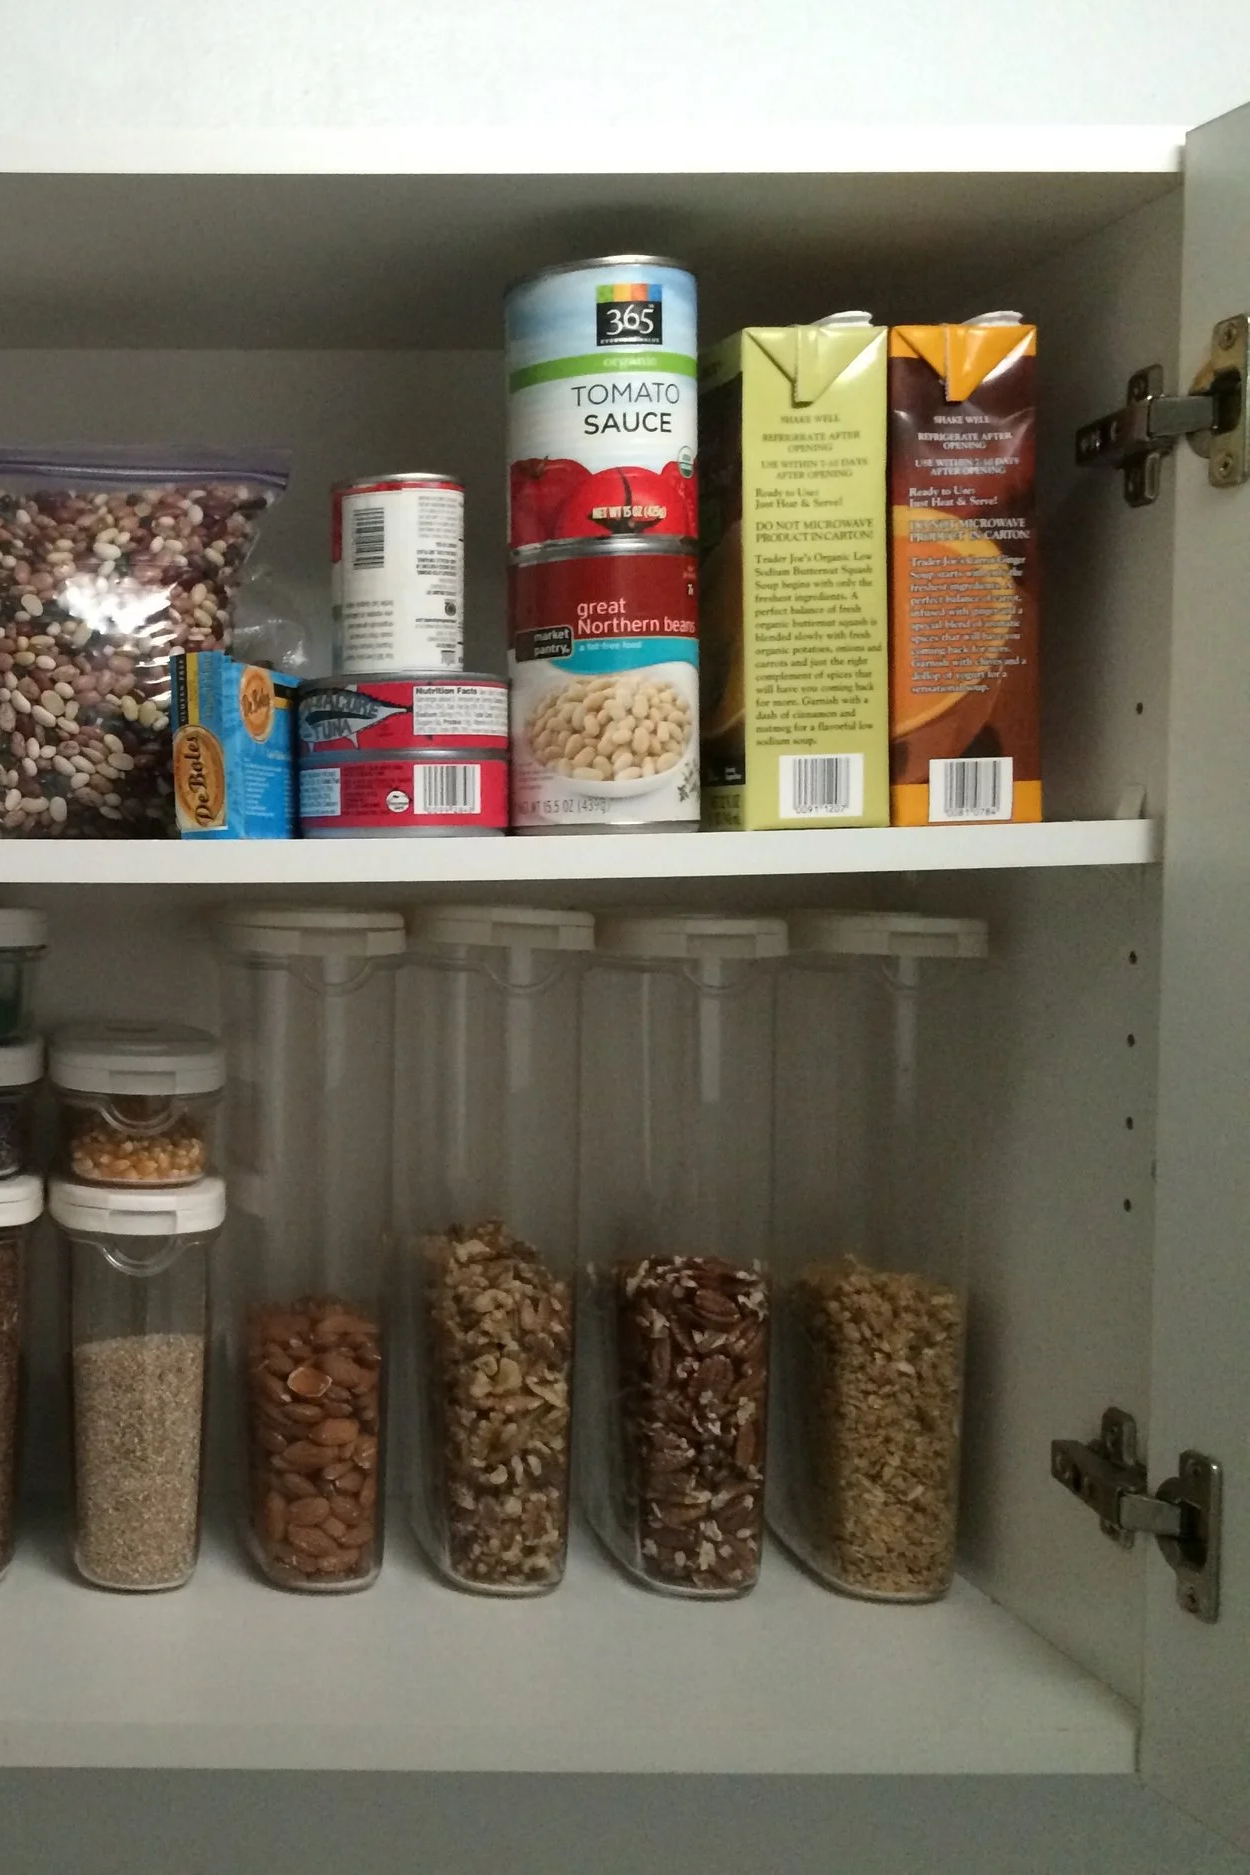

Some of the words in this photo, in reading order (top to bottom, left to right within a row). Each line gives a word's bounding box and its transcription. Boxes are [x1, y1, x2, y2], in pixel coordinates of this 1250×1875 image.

[606, 304, 654, 335] 365
[603, 358, 658, 368] organic
[572, 383, 680, 406] TOMATO
[584, 413, 672, 434] SAUCE
[781, 415, 810, 424] SHAKE
[814, 414, 839, 423] WELL
[934, 416, 963, 424] SHAKE
[762, 432, 826, 442] REFRIGERATE
[829, 431, 860, 440] AFTER
[918, 432, 978, 441] REFRIGERATE
[982, 432, 1012, 440] AFTER
[788, 444, 833, 453] OPENING
[943, 441, 986, 449] OPENING
[841, 458, 868, 466] DAYS
[776, 471, 804, 479] AFTER
[808, 469, 853, 479] OPENING
[756, 488, 782, 498] Ready
[910, 486, 939, 497] Ready
[942, 487, 951, 495] to
[756, 500, 773, 510] Just
[777, 499, 797, 508] Heat
[814, 497, 843, 507] Serve!
[932, 498, 954, 506] Heat
[970, 496, 998, 505] Serve!
[622, 507, 631, 518] 15
[757, 521, 773, 531] DO
[777, 521, 800, 530] NOT
[804, 518, 874, 530] MICROWAVE
[959, 518, 1026, 527] MICROWAVE
[757, 533, 809, 543] PRODUCT
[811, 532, 822, 542] IN
[823, 530, 873, 541] CARTON!
[756, 554, 786, 563] Trader
[814, 553, 850, 562] Organic
[854, 552, 872, 560] Low
[755, 568, 790, 576] Sodium
[793, 566, 838, 576] Butternut
[841, 565, 873, 575] Squash
[577, 598, 626, 619] great
[756, 607, 787, 617] perfect
[790, 606, 824, 614] balance
[827, 605, 837, 613] of
[840, 605, 861, 613] fresh
[578, 617, 659, 635] Northern
[664, 616, 695, 633] beans
[534, 629, 569, 642] market
[756, 633, 791, 641] blended
[795, 632, 823, 641] slowly
[827, 632, 846, 640] with
[850, 631, 870, 639] fresh
[588, 642, 620, 650] fat-free
[623, 641, 642, 649] food
[415, 687, 454, 695] Nutrition
[457, 687, 477, 695] Facts
[313, 719, 352, 740] TUNA
[756, 737, 790, 745] sodium
[793, 738, 817, 746] soup.
